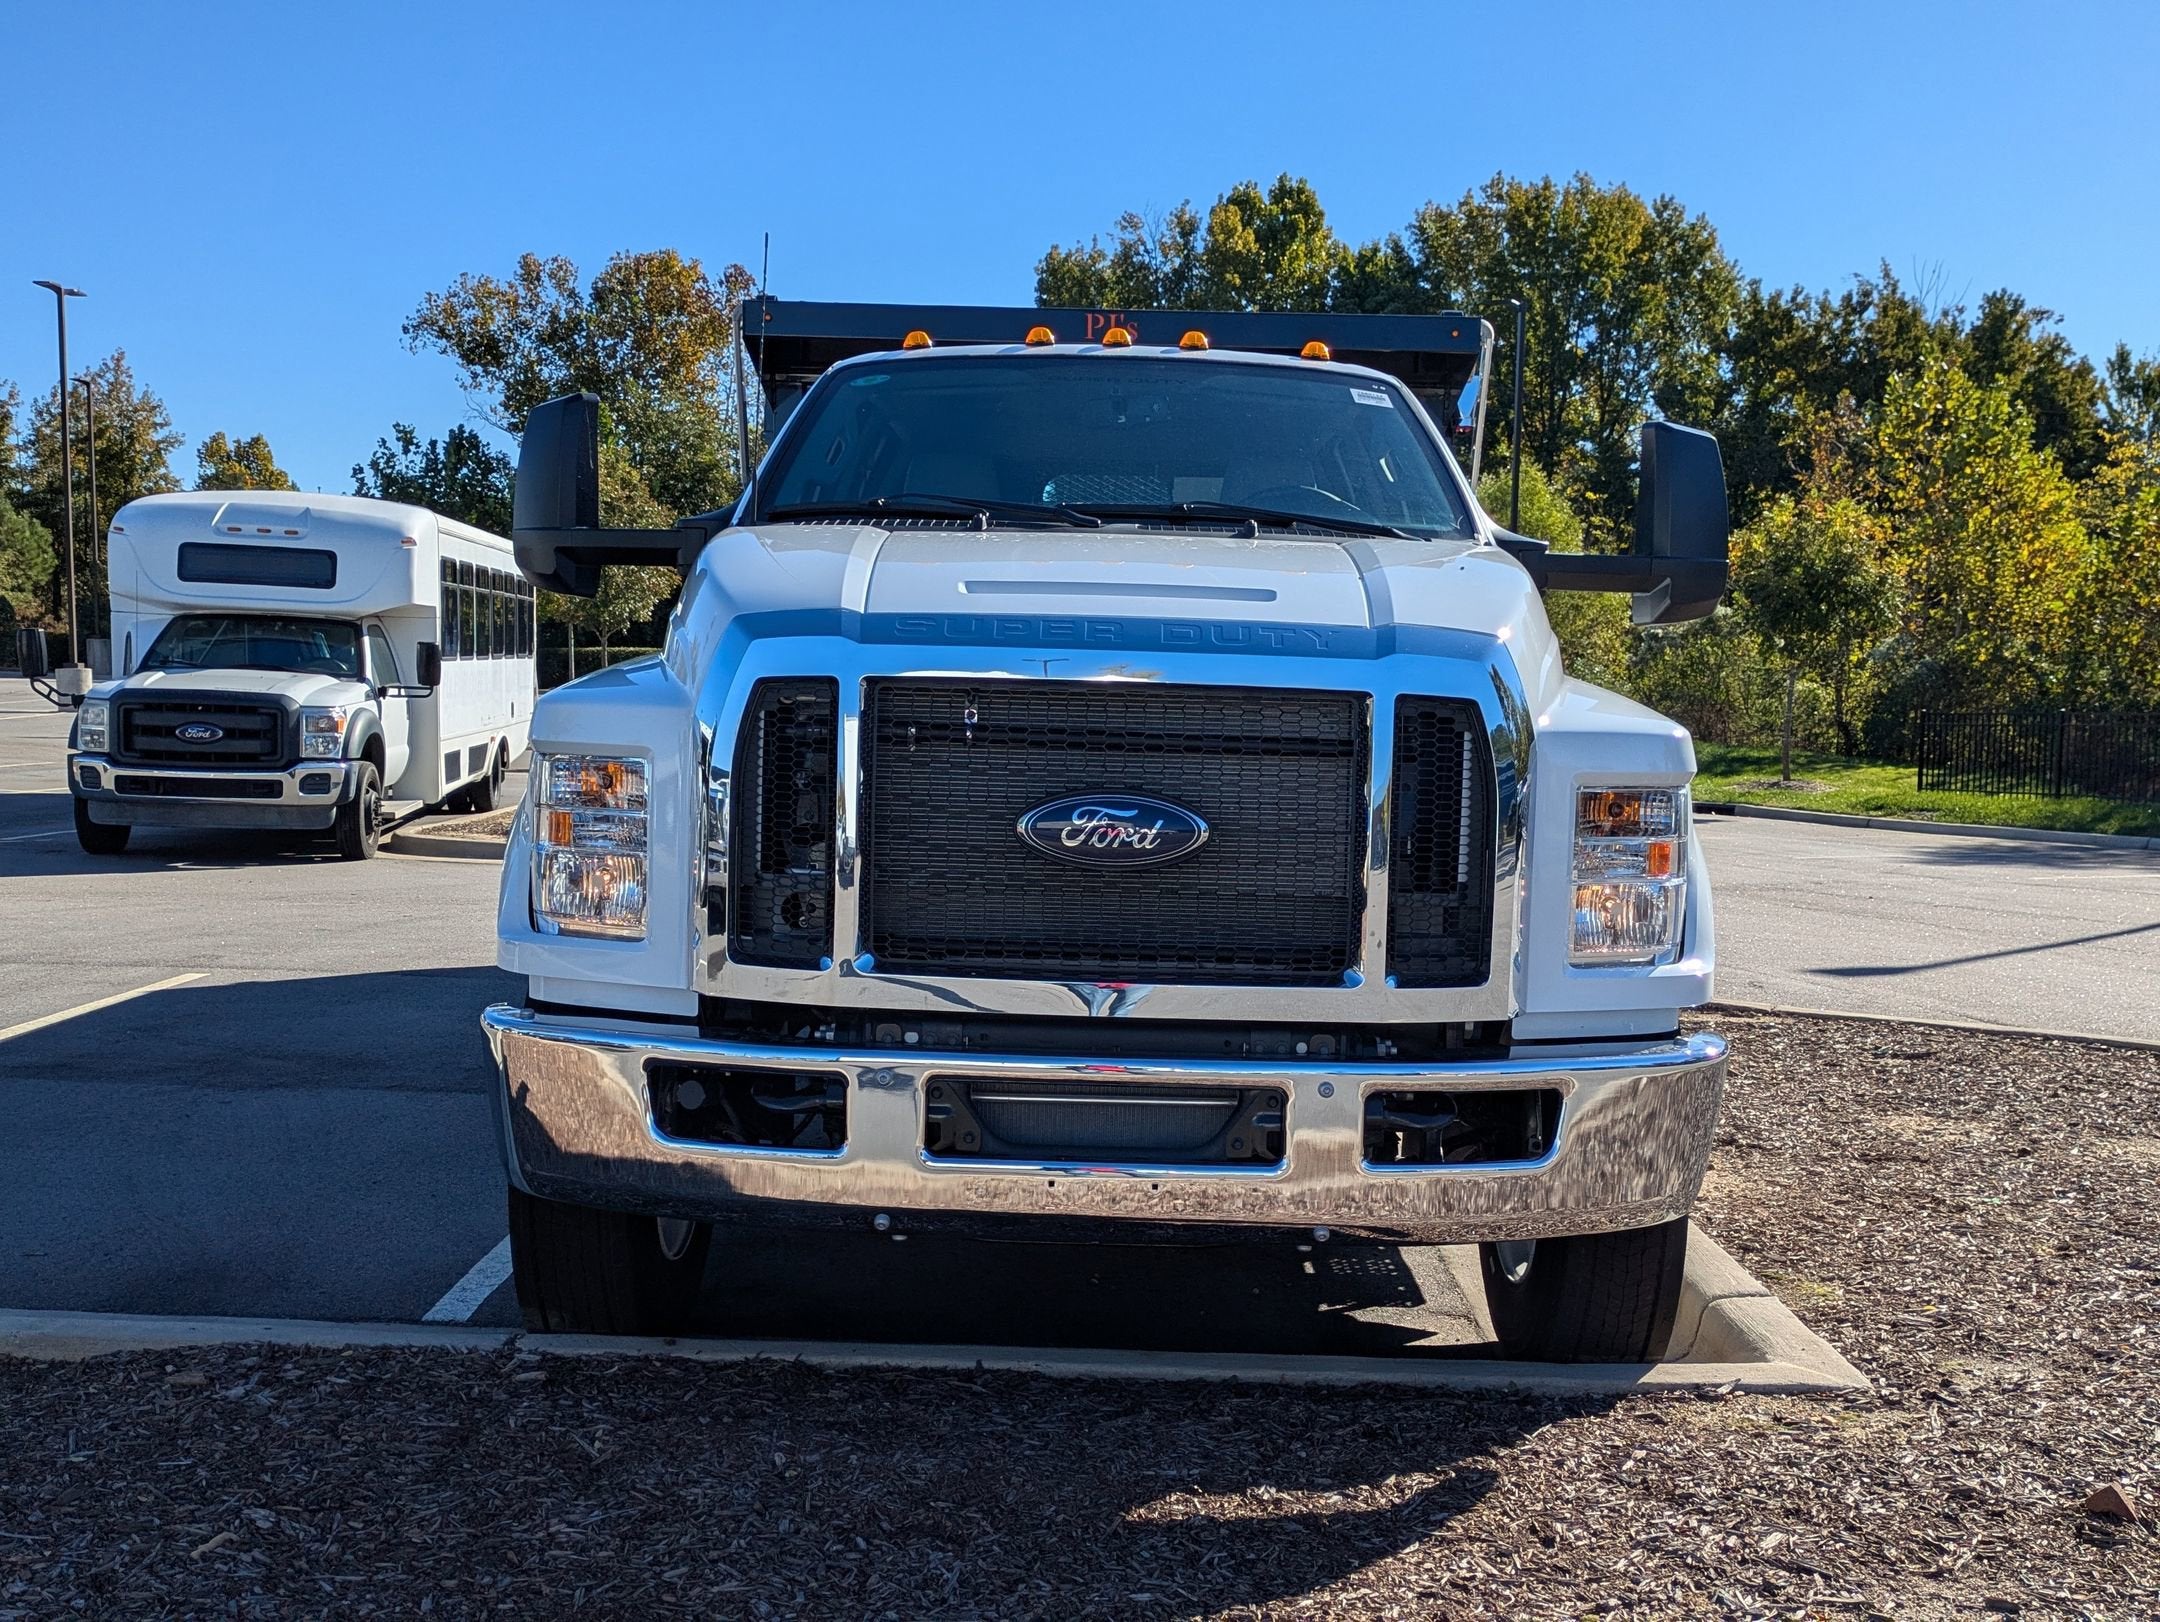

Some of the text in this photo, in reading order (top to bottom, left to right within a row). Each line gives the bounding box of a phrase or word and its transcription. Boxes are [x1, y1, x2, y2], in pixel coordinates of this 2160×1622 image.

[894, 617, 1342, 650] SUPER DUTY
[184, 727, 212, 738] Ford
[1060, 806, 1165, 850] Ford
